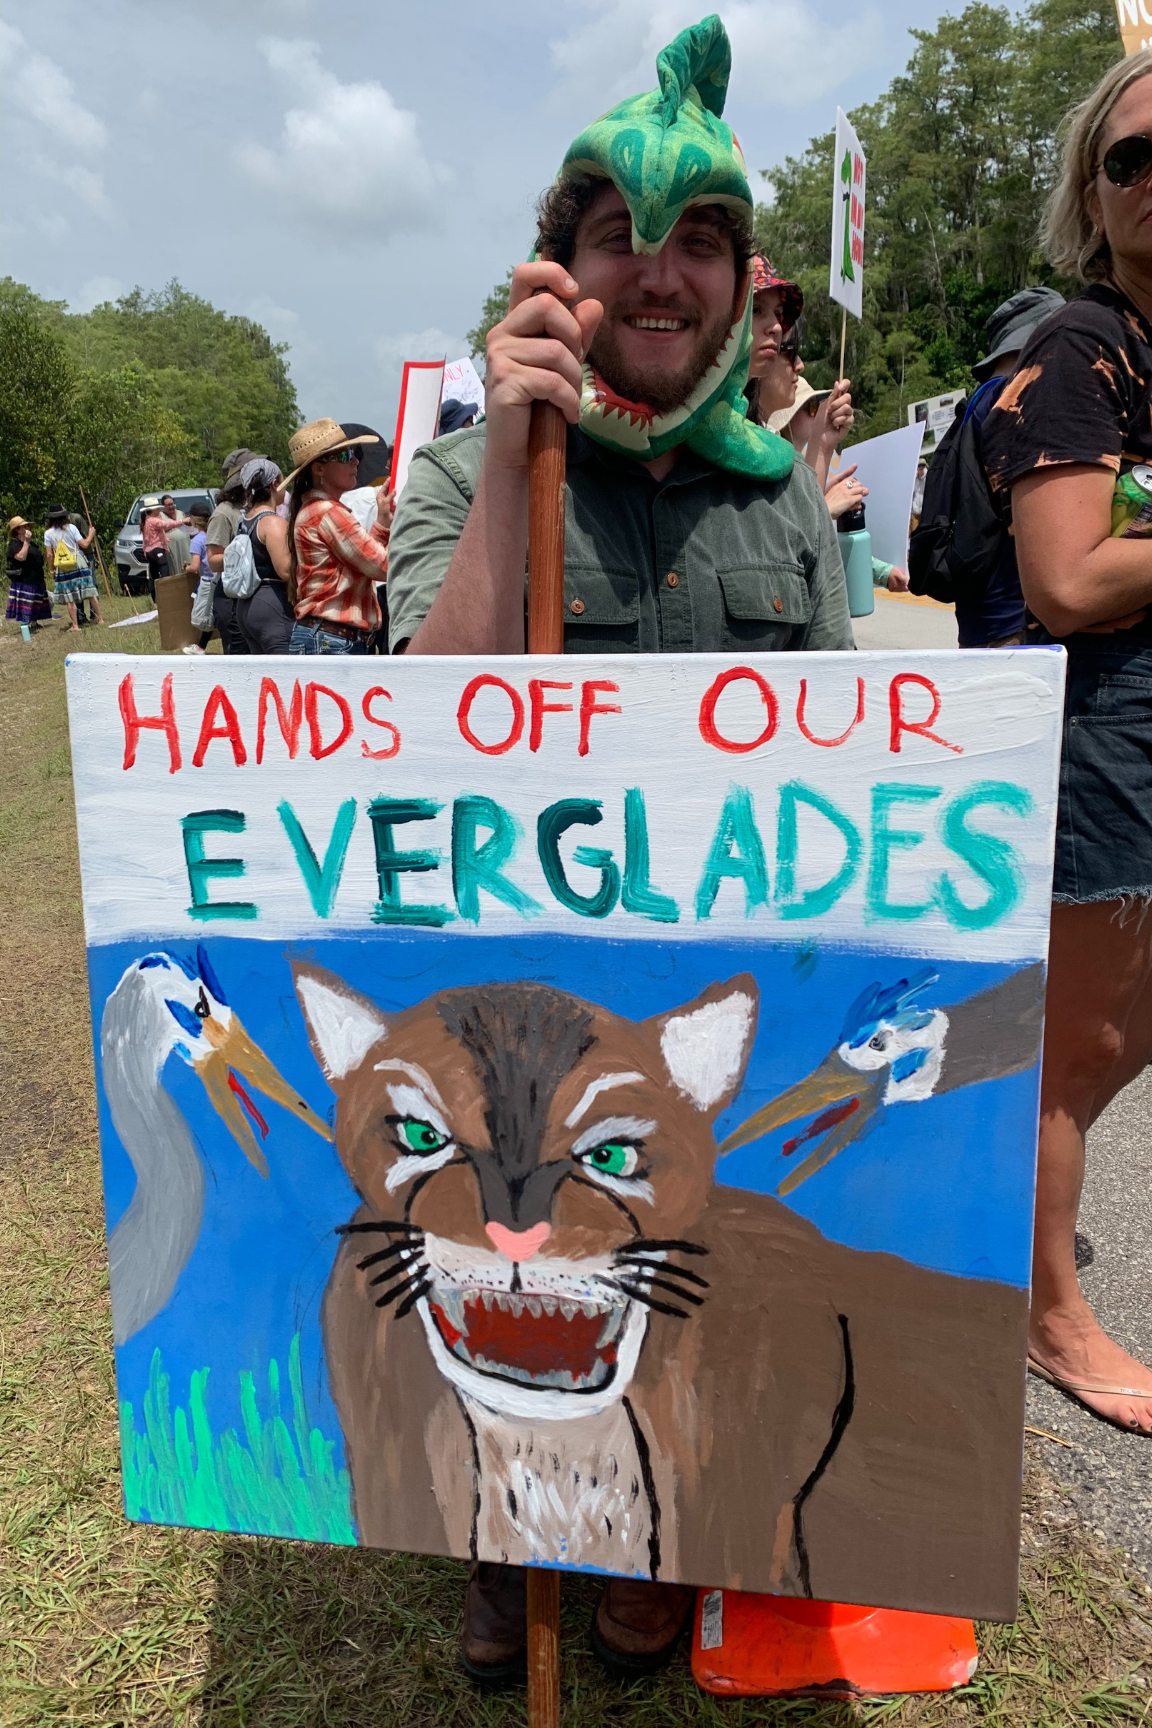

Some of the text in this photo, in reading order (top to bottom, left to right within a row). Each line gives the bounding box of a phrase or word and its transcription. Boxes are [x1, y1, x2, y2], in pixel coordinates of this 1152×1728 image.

[443, 364, 464, 384] NLY
[117, 666, 964, 774] HANDS OFF OUR
[179, 778, 1033, 932] EVERGLADES
